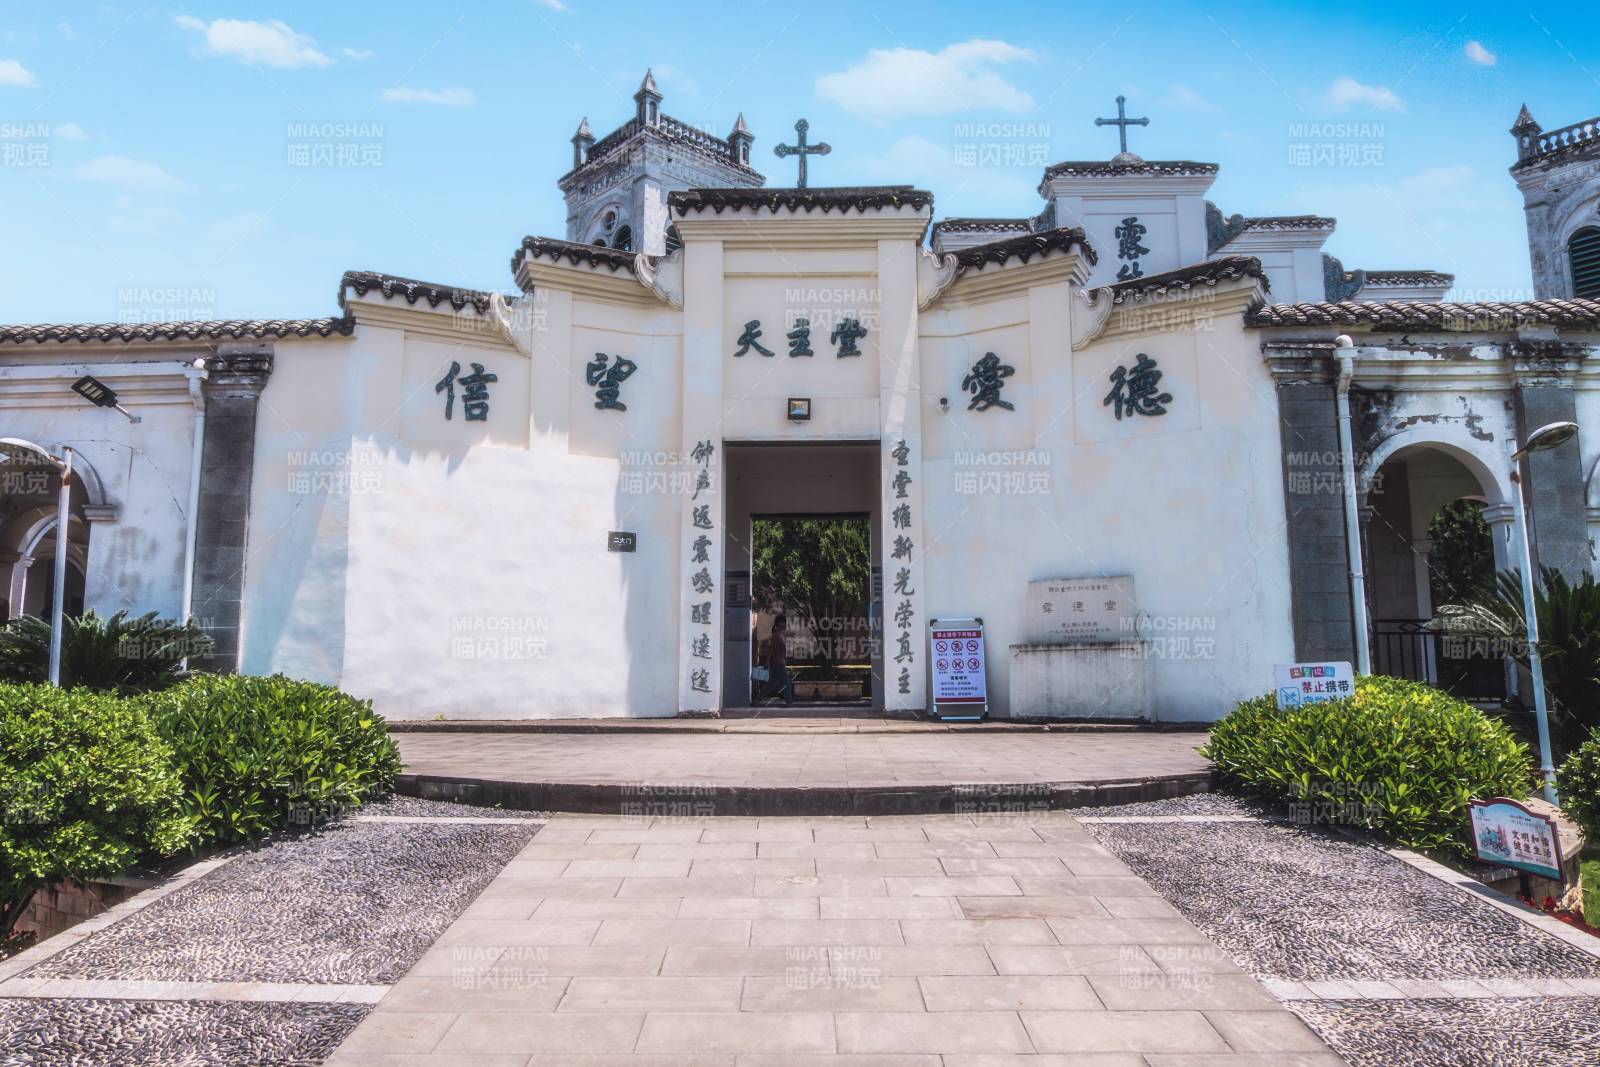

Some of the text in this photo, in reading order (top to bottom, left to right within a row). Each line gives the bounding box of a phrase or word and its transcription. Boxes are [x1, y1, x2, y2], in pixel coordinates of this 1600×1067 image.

[733, 318, 868, 360] 天主堂
[435, 360, 498, 421] 信
[586, 352, 638, 412] 望
[1103, 352, 1173, 421] 德
[1302, 680, 1350, 693] 禁止携带
